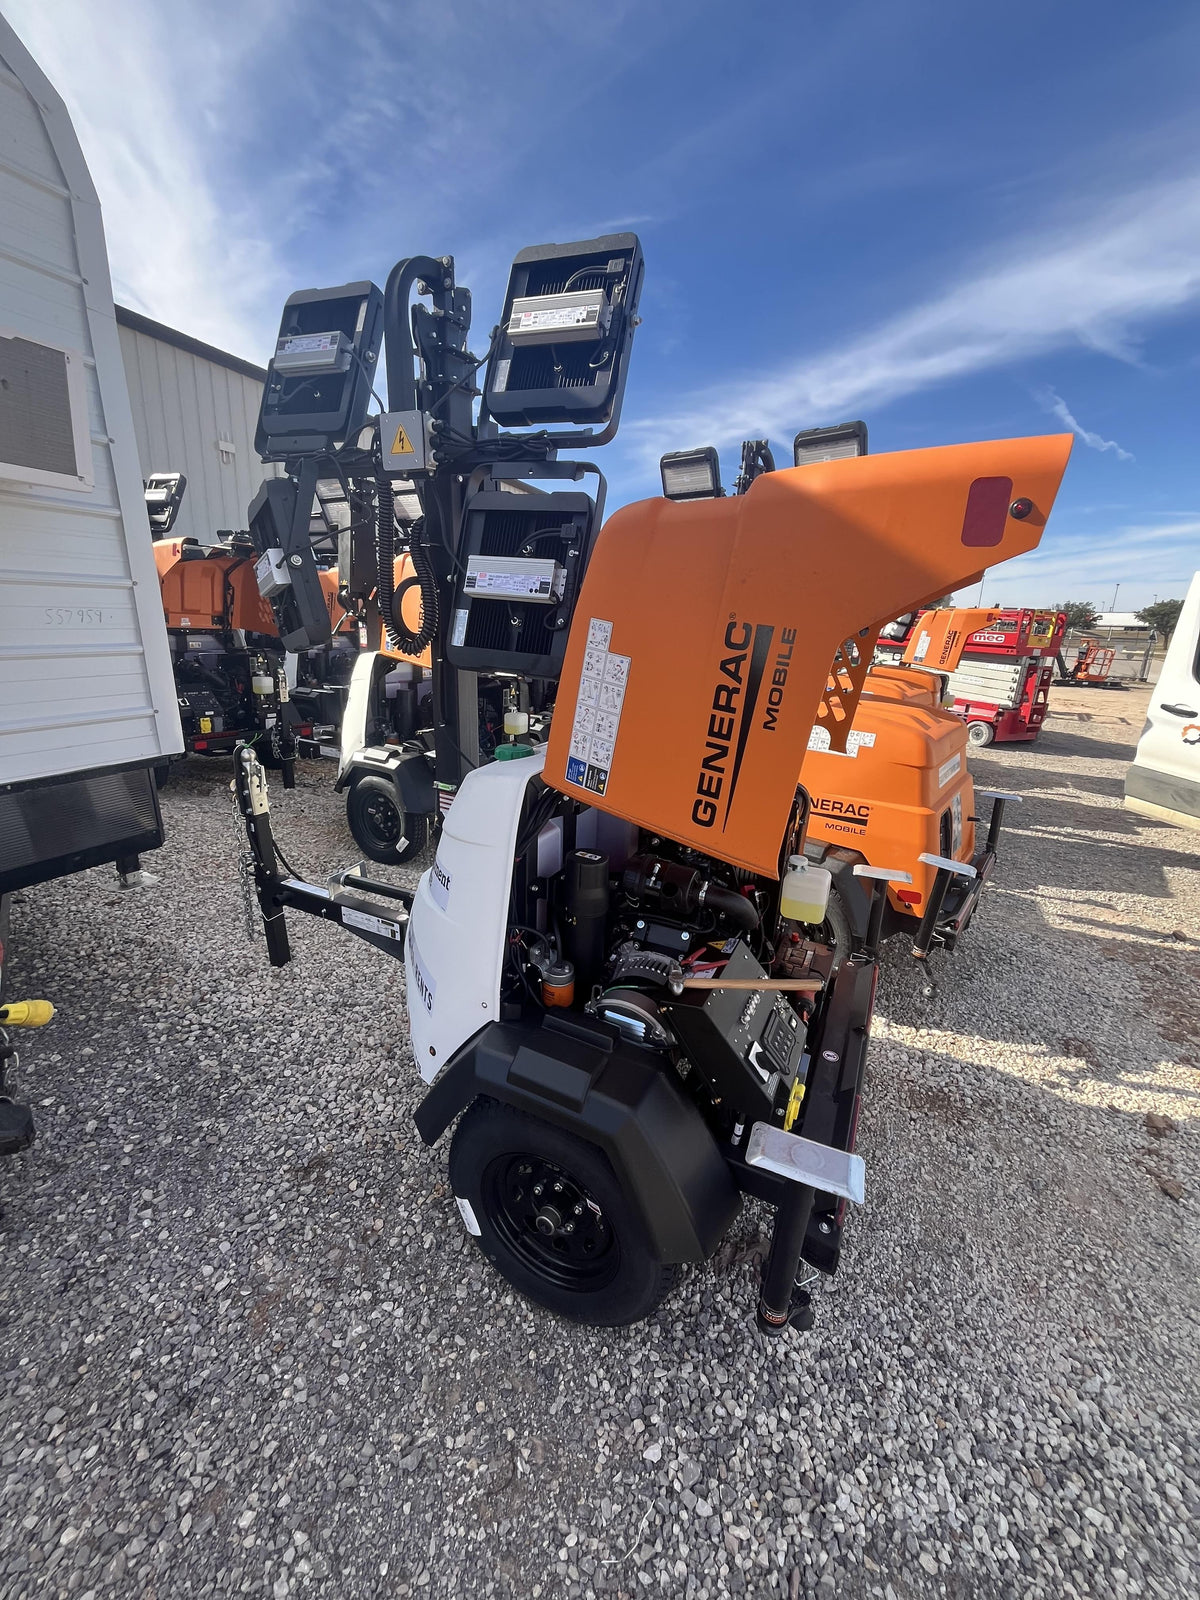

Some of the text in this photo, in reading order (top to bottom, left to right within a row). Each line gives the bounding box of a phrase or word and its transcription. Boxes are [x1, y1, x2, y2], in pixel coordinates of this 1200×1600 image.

[45, 608, 102, 625] 557959
[974, 634, 1004, 642] mec
[939, 630, 954, 665] GENERAC
[762, 627, 797, 731] MOBILE
[810, 797, 870, 817] NERAC
[825, 823, 866, 835] MOBILE
